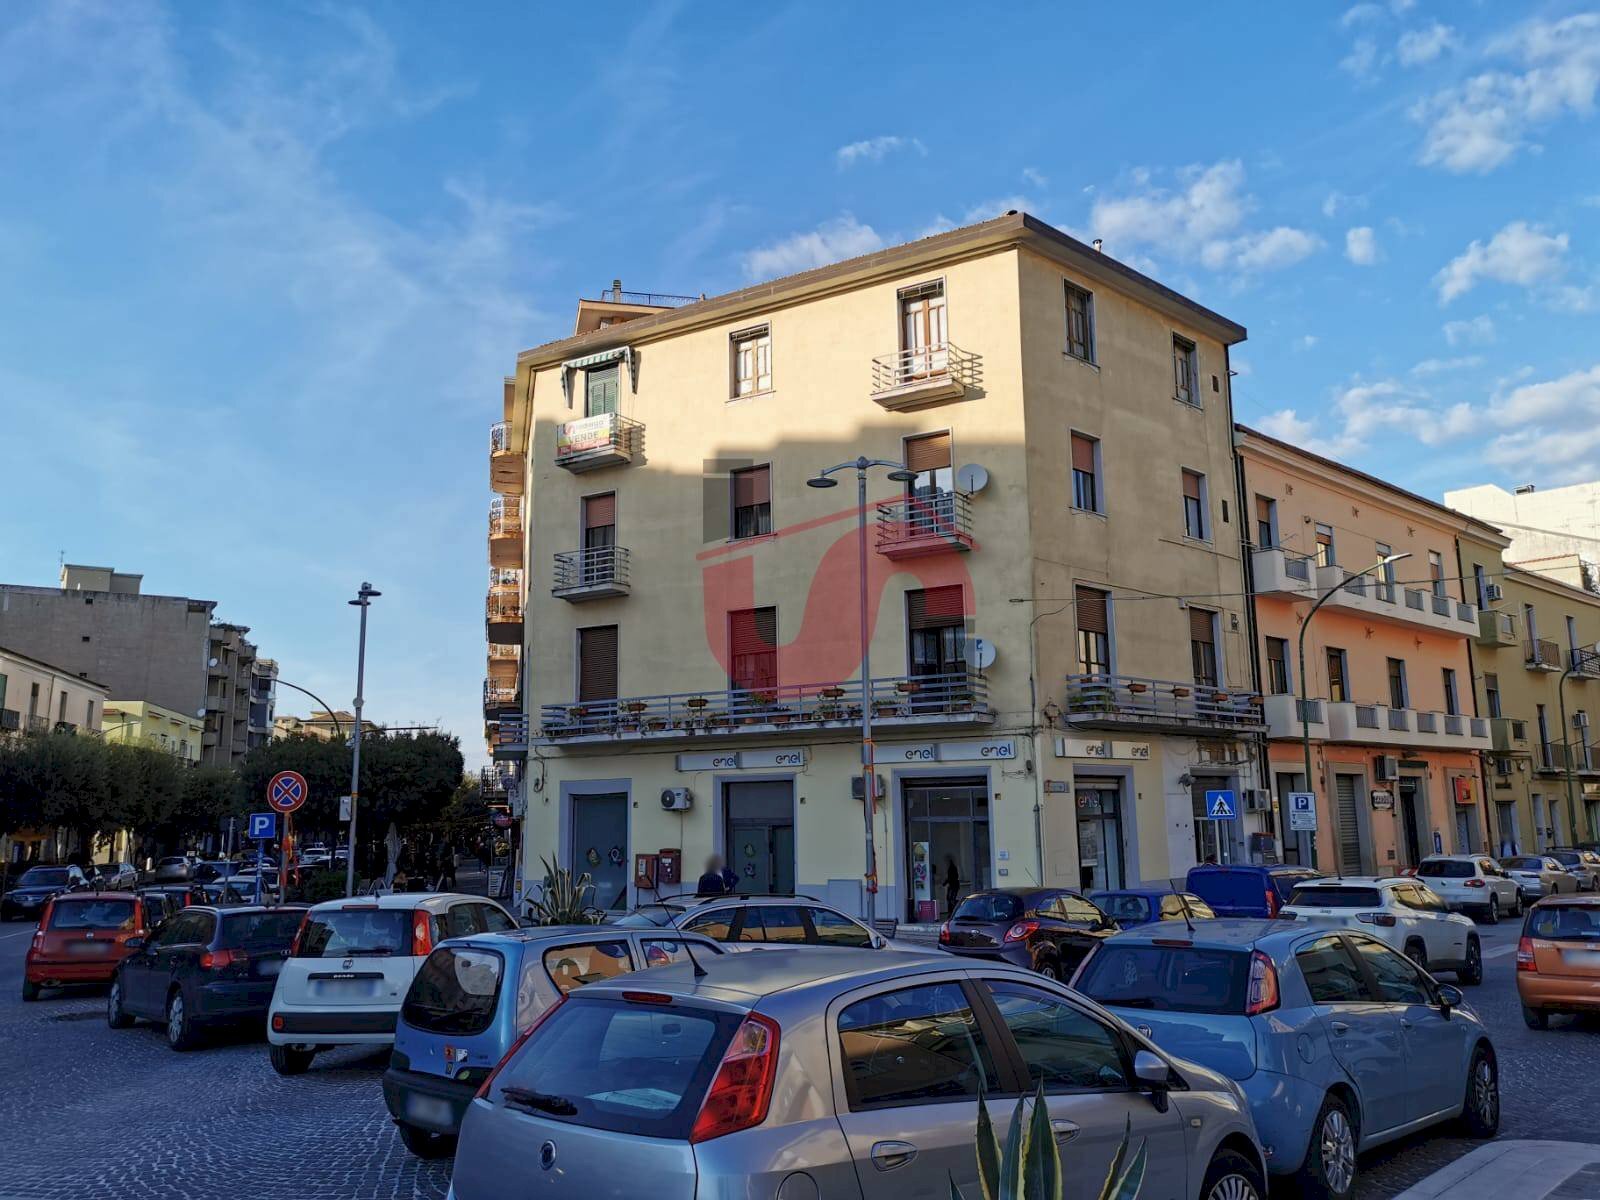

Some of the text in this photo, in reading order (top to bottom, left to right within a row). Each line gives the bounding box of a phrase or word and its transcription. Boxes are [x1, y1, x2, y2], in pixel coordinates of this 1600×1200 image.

[568, 432, 599, 444] VENDE
[905, 746, 933, 760] enel
[981, 743, 1011, 757] enel
[1086, 743, 1105, 756] enel
[1131, 745, 1149, 758] enel
[712, 755, 737, 768] enel
[775, 751, 801, 765] enel
[1298, 797, 1307, 809] P
[254, 816, 270, 835] P
